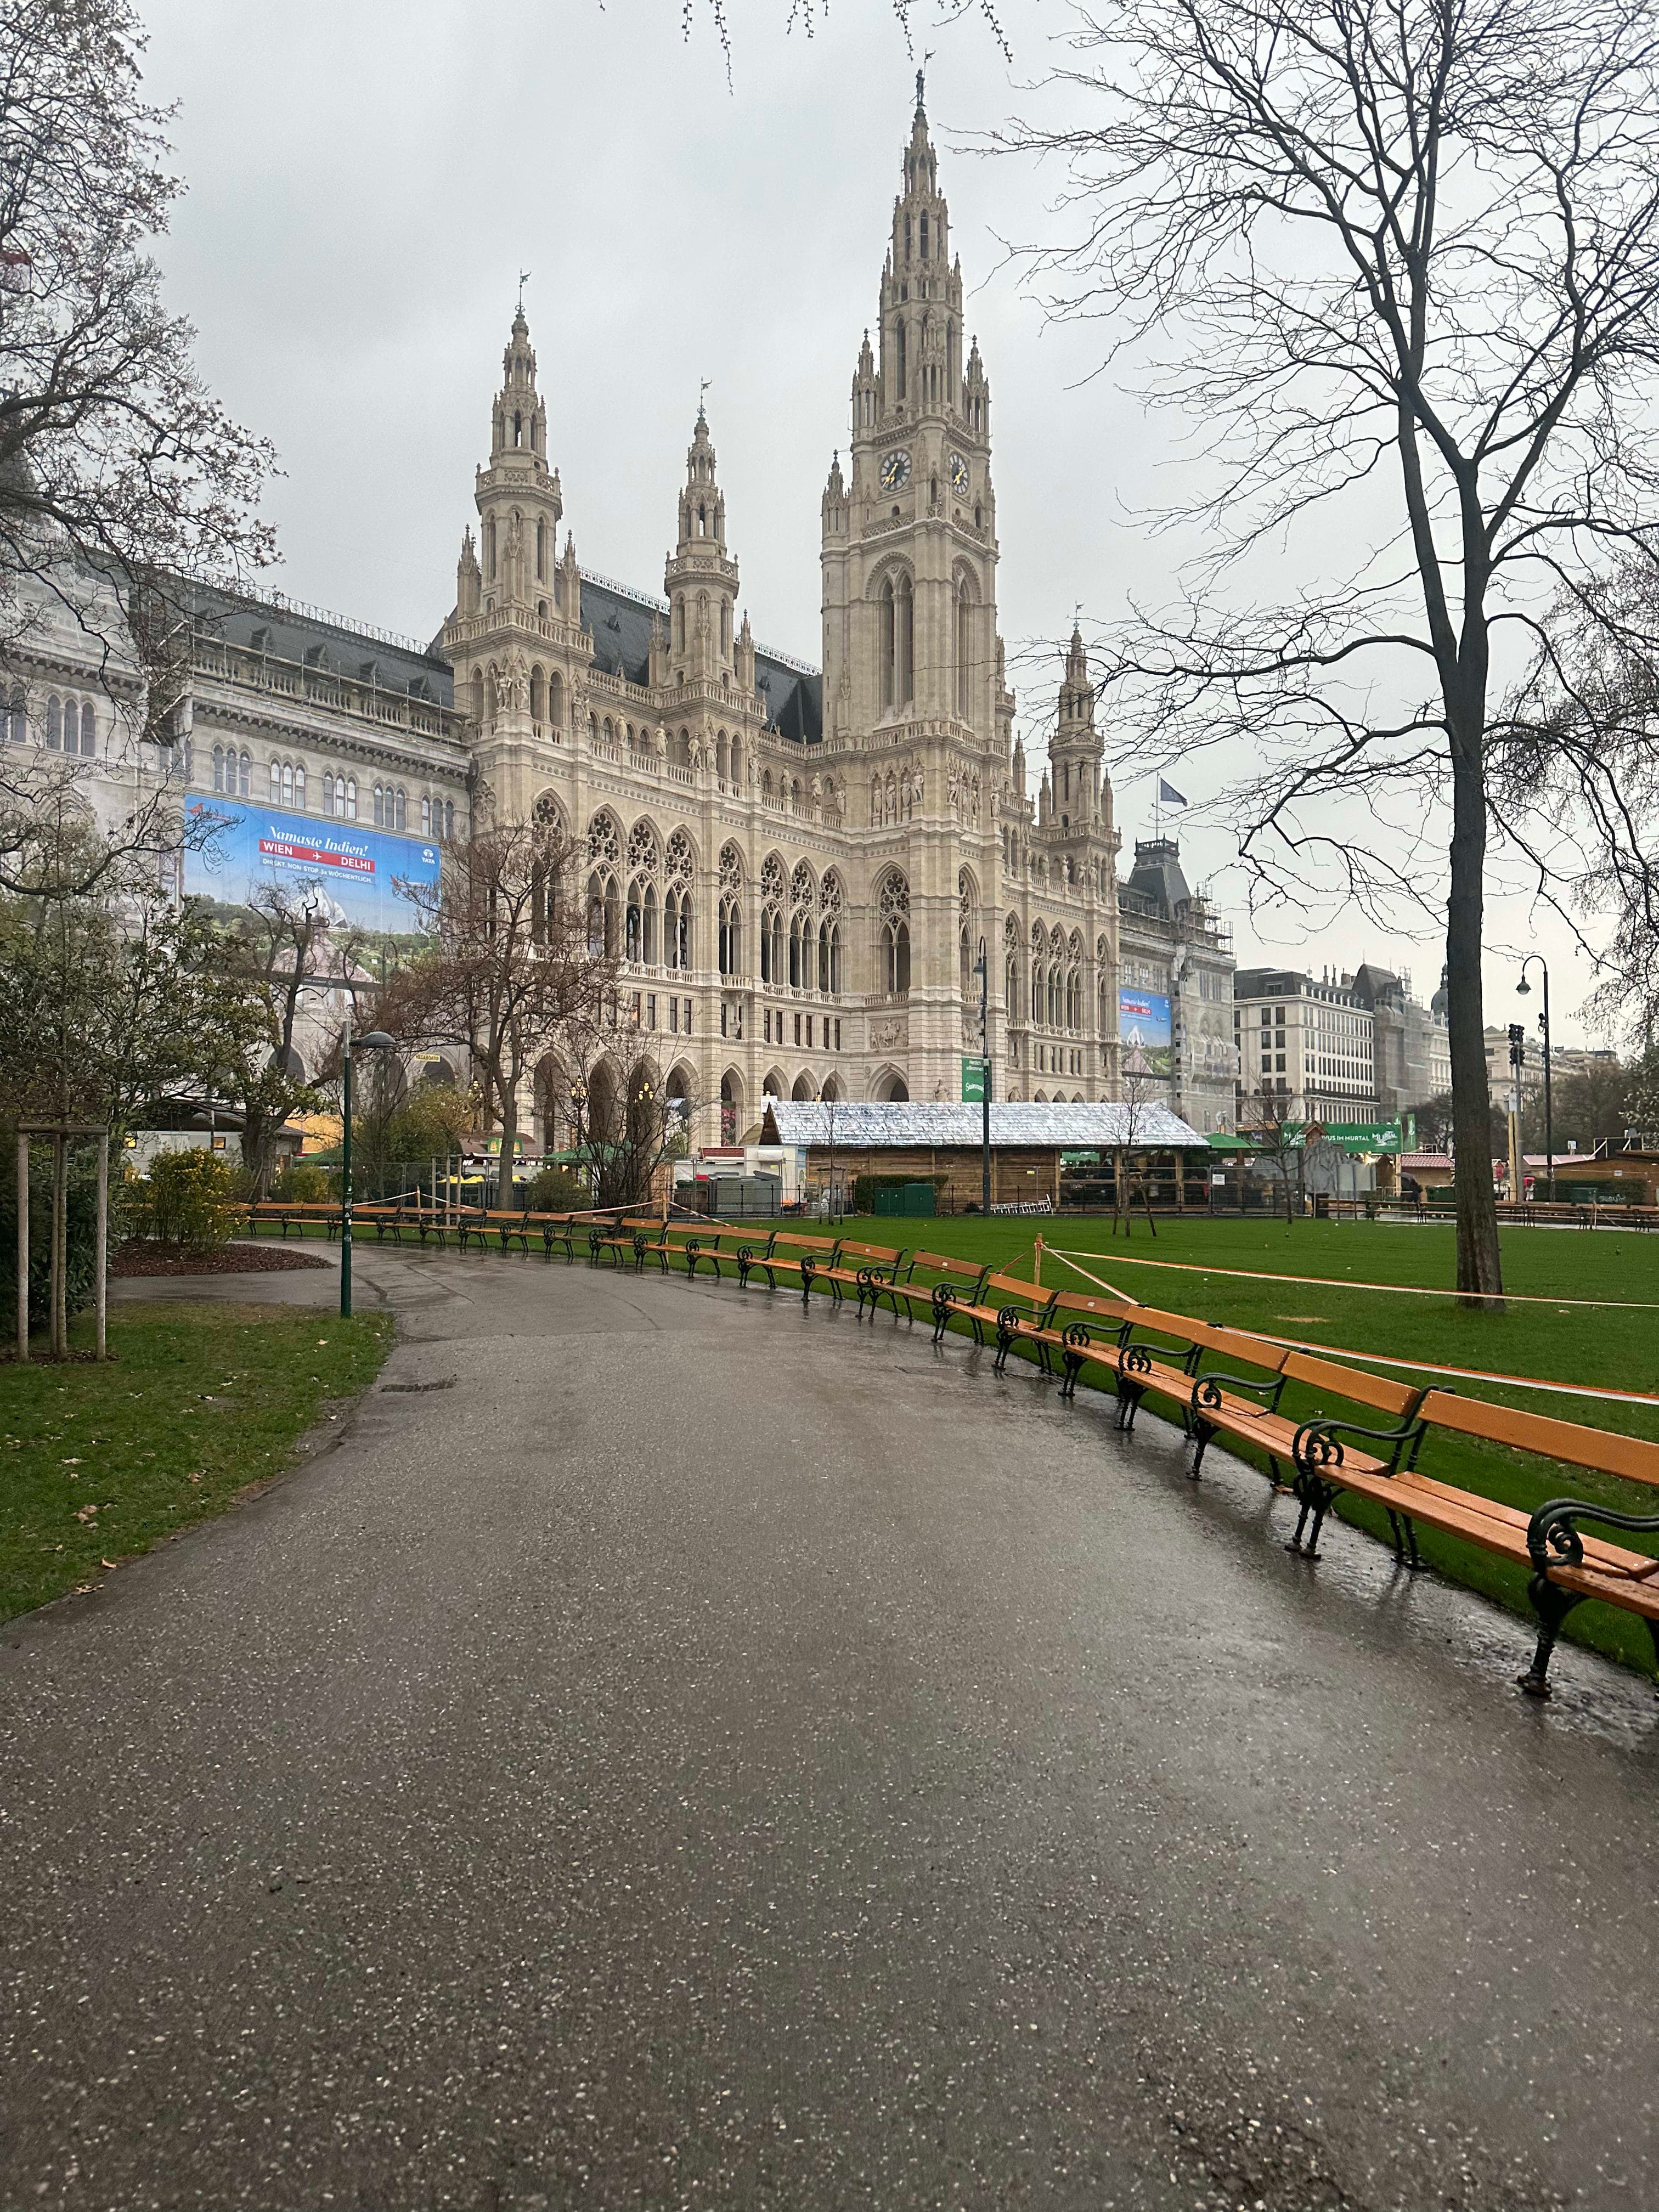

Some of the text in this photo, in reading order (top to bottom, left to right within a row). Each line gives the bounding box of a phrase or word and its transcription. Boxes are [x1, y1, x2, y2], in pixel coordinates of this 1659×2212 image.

[263, 841, 370, 871] WIEN DELHI
[268, 826, 369, 856] Namaste Indien!
[287, 862, 302, 871] NON
